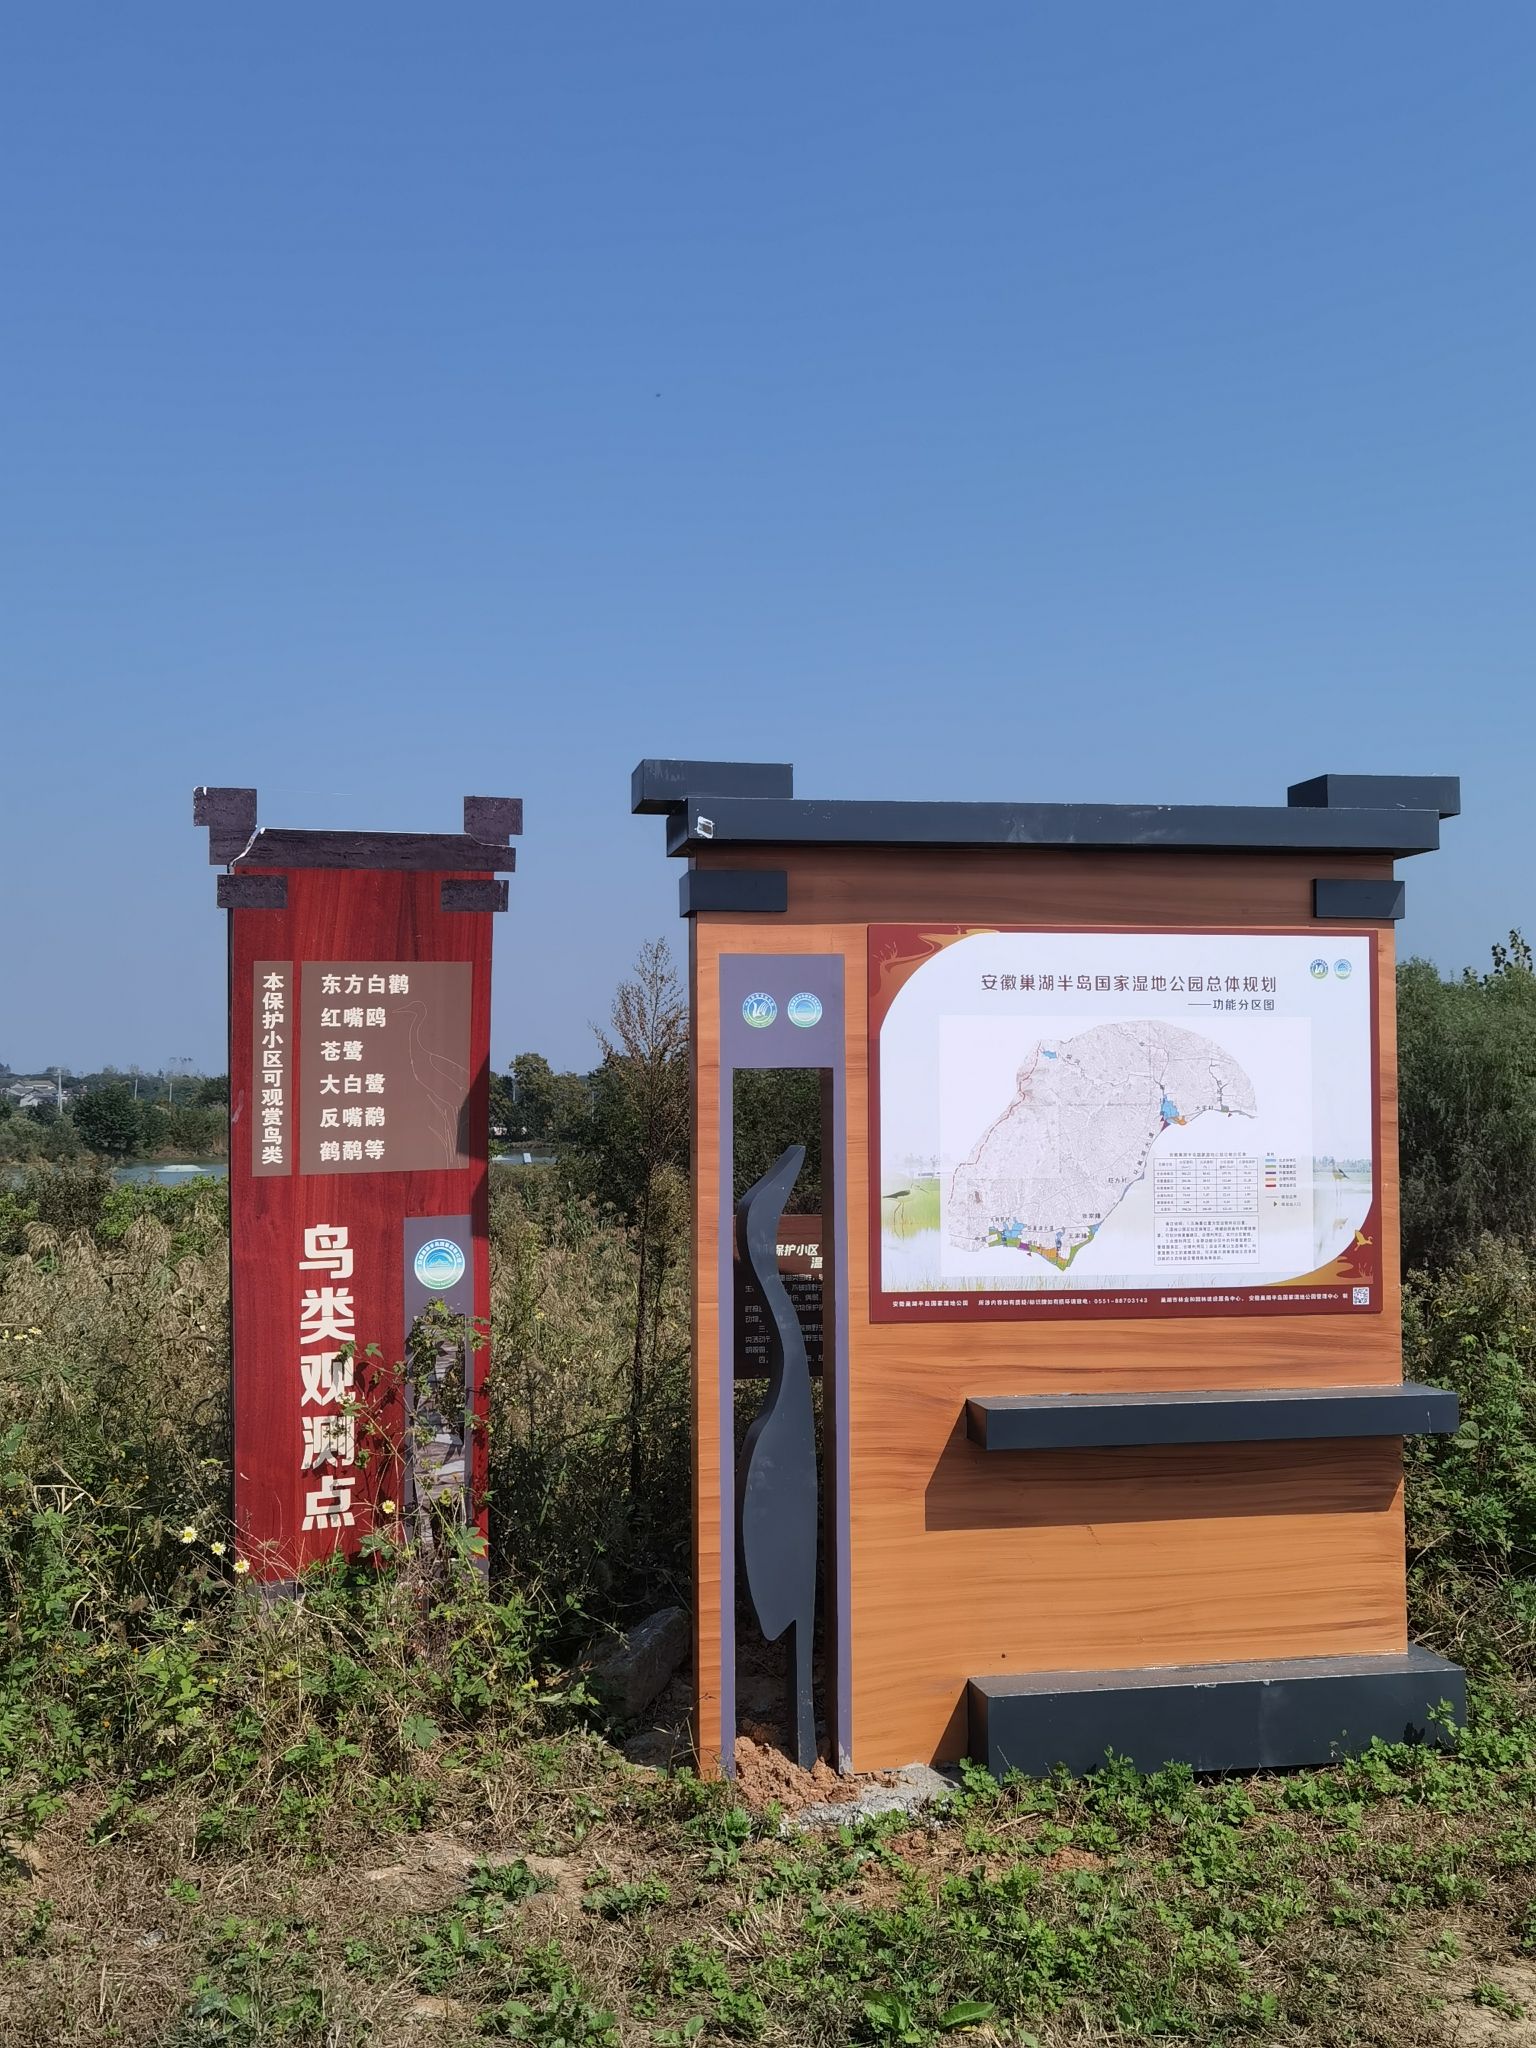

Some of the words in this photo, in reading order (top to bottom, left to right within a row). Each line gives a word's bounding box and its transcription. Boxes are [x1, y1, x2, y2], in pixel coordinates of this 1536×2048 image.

[321, 973, 409, 995] 东方白鹳
[981, 974, 1276, 993] 安徽巢湖半岛国家湿地公园总体规划
[320, 1006, 386, 1028] 红嘴鸥
[320, 1040, 364, 1062] 苍鹭
[261, 972, 285, 1165] 本保护小区可观赏鸟类
[319, 1073, 386, 1095] 大白鹭
[319, 1106, 386, 1128] 反嘴鹬
[319, 1139, 386, 1161] 鹤鹬等
[299, 1223, 356, 1531] 鸟类观测点
